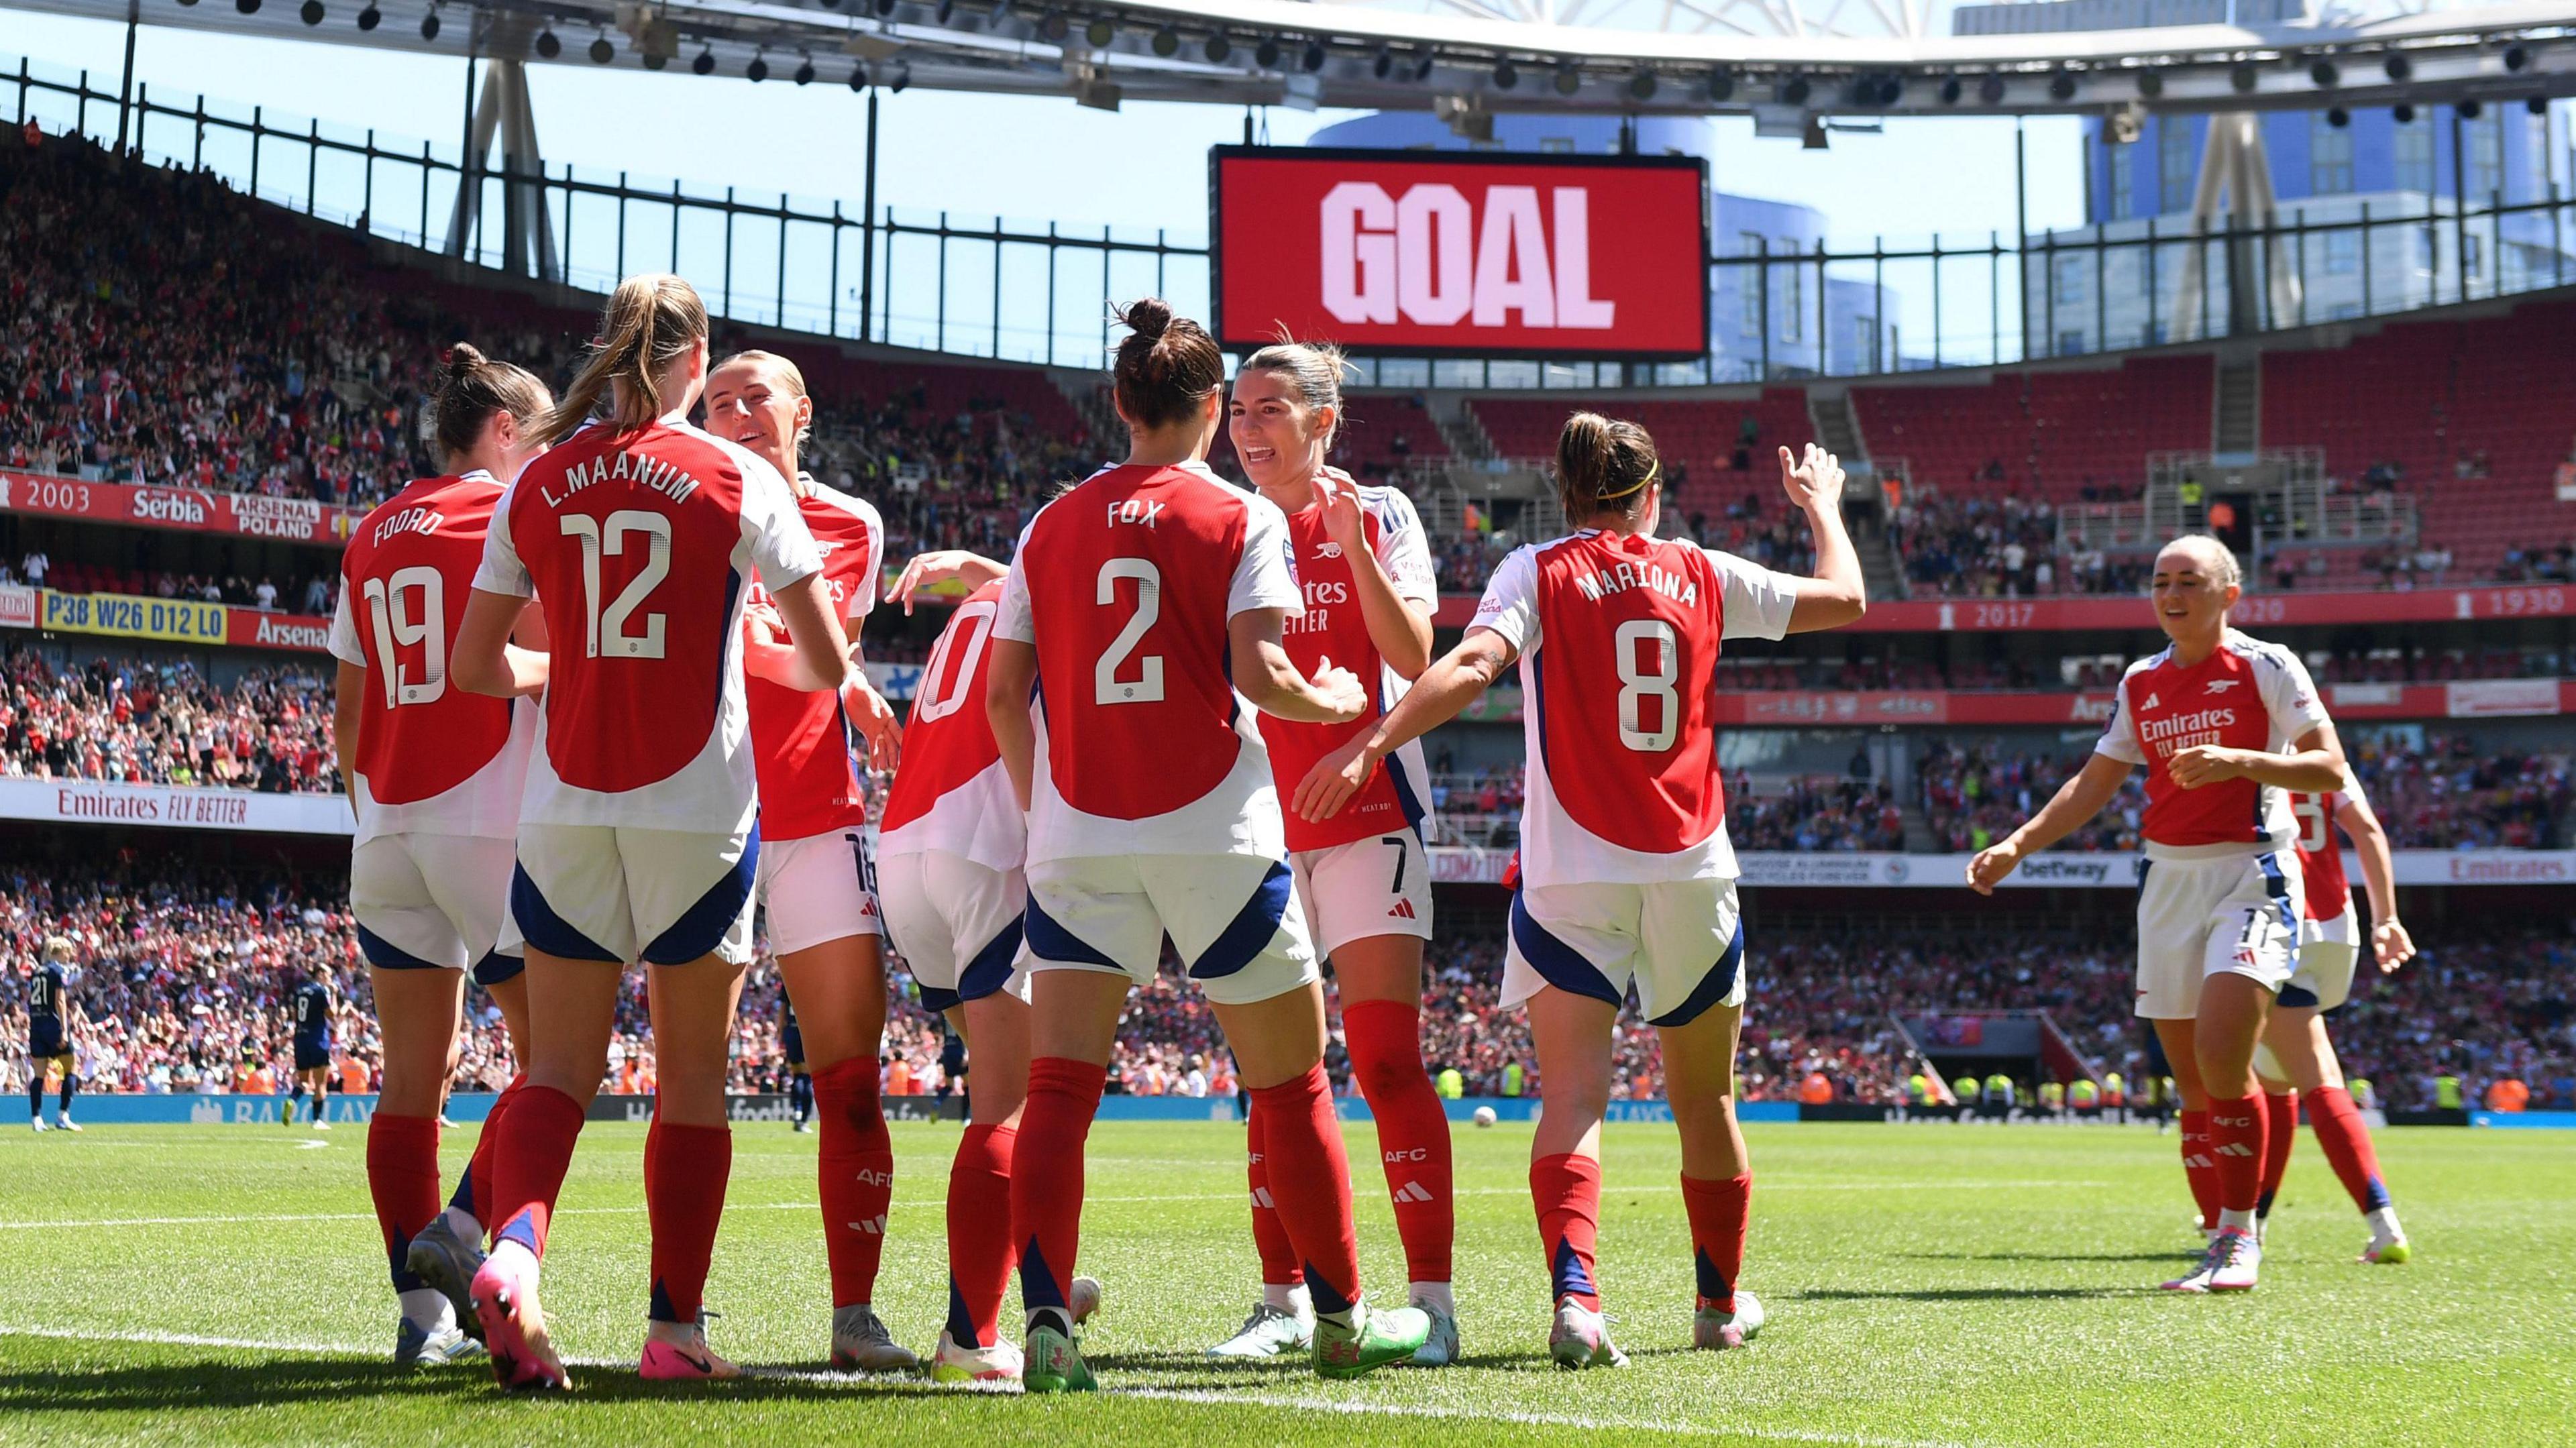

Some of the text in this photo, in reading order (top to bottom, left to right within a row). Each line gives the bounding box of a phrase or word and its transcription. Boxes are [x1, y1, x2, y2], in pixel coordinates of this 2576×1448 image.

[1320, 181, 1615, 329] GOAL
[541, 451, 701, 508] L.MAANUM
[27, 480, 90, 513] 2003
[133, 488, 204, 524] Serbia
[235, 496, 317, 520] ARSENAL
[239, 514, 313, 540] POLAND
[373, 507, 445, 549] FOORD
[1107, 499, 1166, 529] FOX
[559, 509, 672, 659] 12
[1575, 560, 1697, 609] MARIONA
[47, 594, 89, 626] P38
[96, 598, 143, 631] W26
[151, 604, 191, 634] D12
[1976, 603, 2035, 628] 2017
[2234, 599, 2285, 622] 020
[2491, 588, 2565, 615] 1930
[256, 616, 334, 648] Arsenal
[363, 565, 445, 710] 19
[1095, 557, 1165, 706] 2
[1282, 608, 1328, 636] ETTER
[1615, 619, 1678, 753] 8
[2140, 708, 2236, 742] Emirates
[58, 788, 248, 824] Emirates FLY BETTER
[1383, 837, 1407, 894] 7
[2022, 859, 2108, 883] betway
[30, 975, 48, 1005] 21
[297, 996, 309, 1022] 8
[1385, 1148, 1426, 1163] AFC
